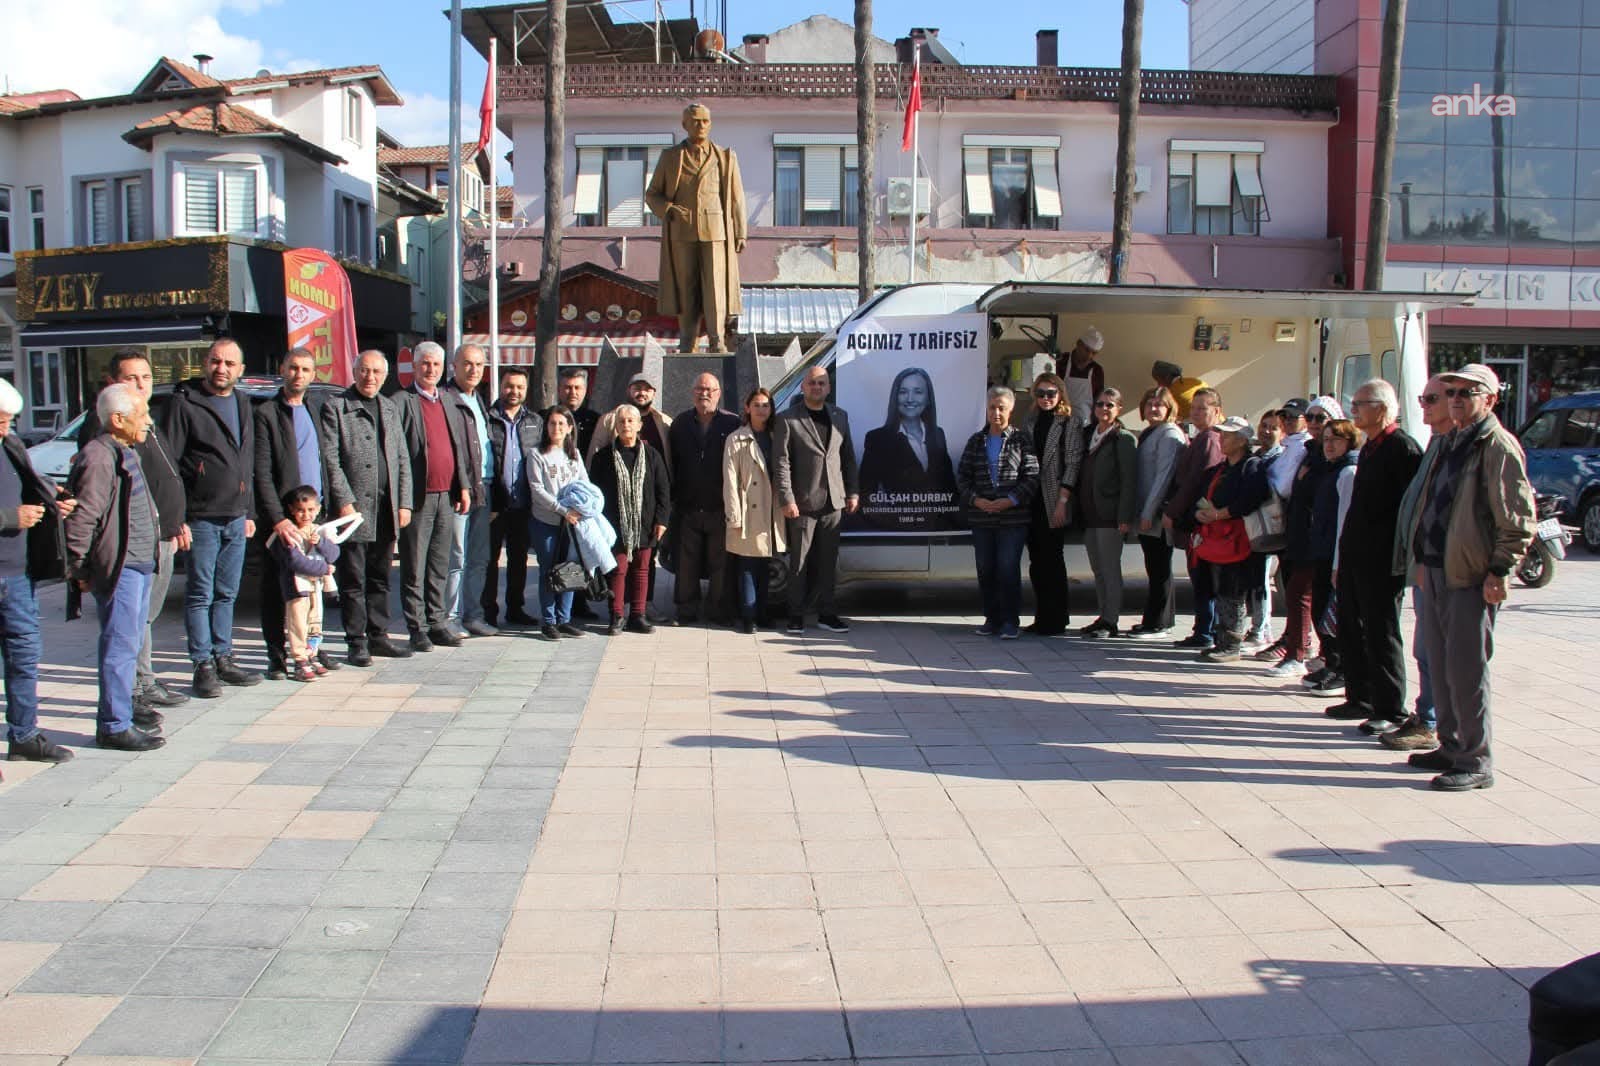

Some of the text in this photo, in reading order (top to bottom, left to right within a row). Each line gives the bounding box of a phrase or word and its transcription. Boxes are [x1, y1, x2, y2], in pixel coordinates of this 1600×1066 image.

[35, 272, 102, 313] ZEY
[847, 333, 903, 350] ACIMIZ
[869, 491, 953, 504] GÜLŞAH DURBAY
